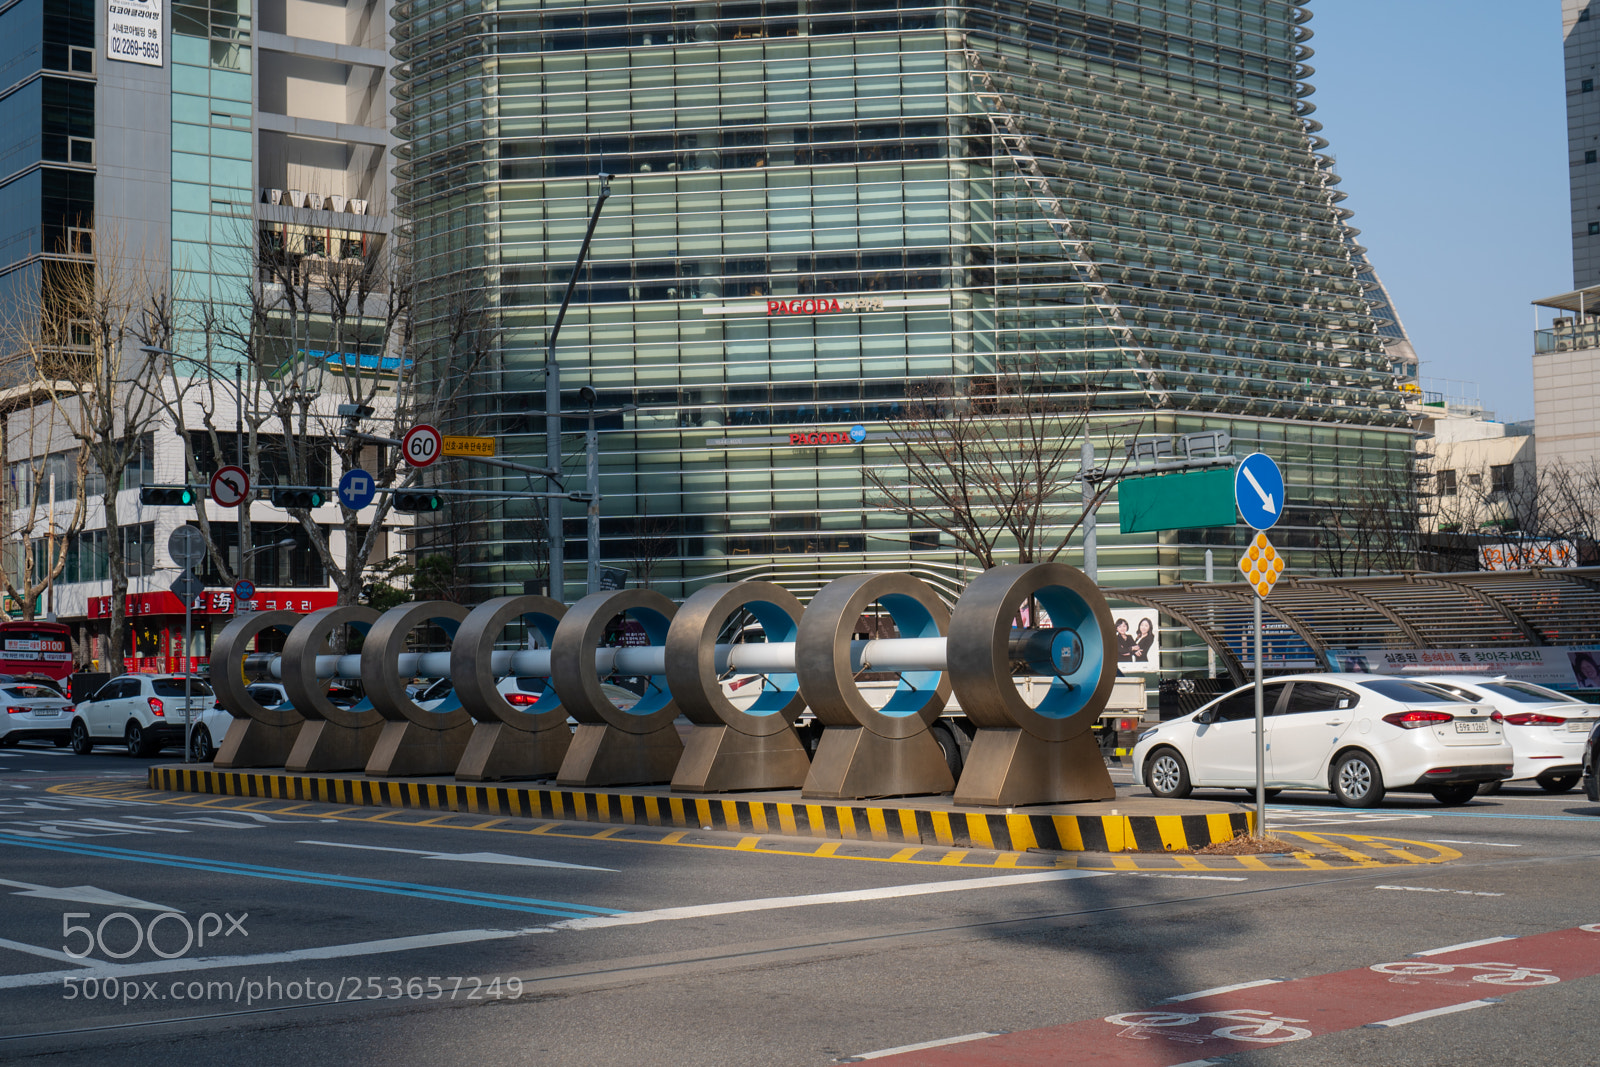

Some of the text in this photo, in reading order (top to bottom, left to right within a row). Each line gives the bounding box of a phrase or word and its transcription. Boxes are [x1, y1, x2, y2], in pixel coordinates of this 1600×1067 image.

[112, 23, 158, 39] 시네코아빌딩 9층
[112, 37, 159, 59] 02 2269-5659
[766, 296, 885, 315] PAGODA 어학원
[789, 429, 865, 445] PAGODA ONE
[411, 437, 434, 455] 60
[41, 641, 63, 651] 8100
[1384, 652, 1419, 663] 실종된
[1459, 652, 1471, 662] 좀
[1474, 650, 1542, 661] 찾아주세요!!
